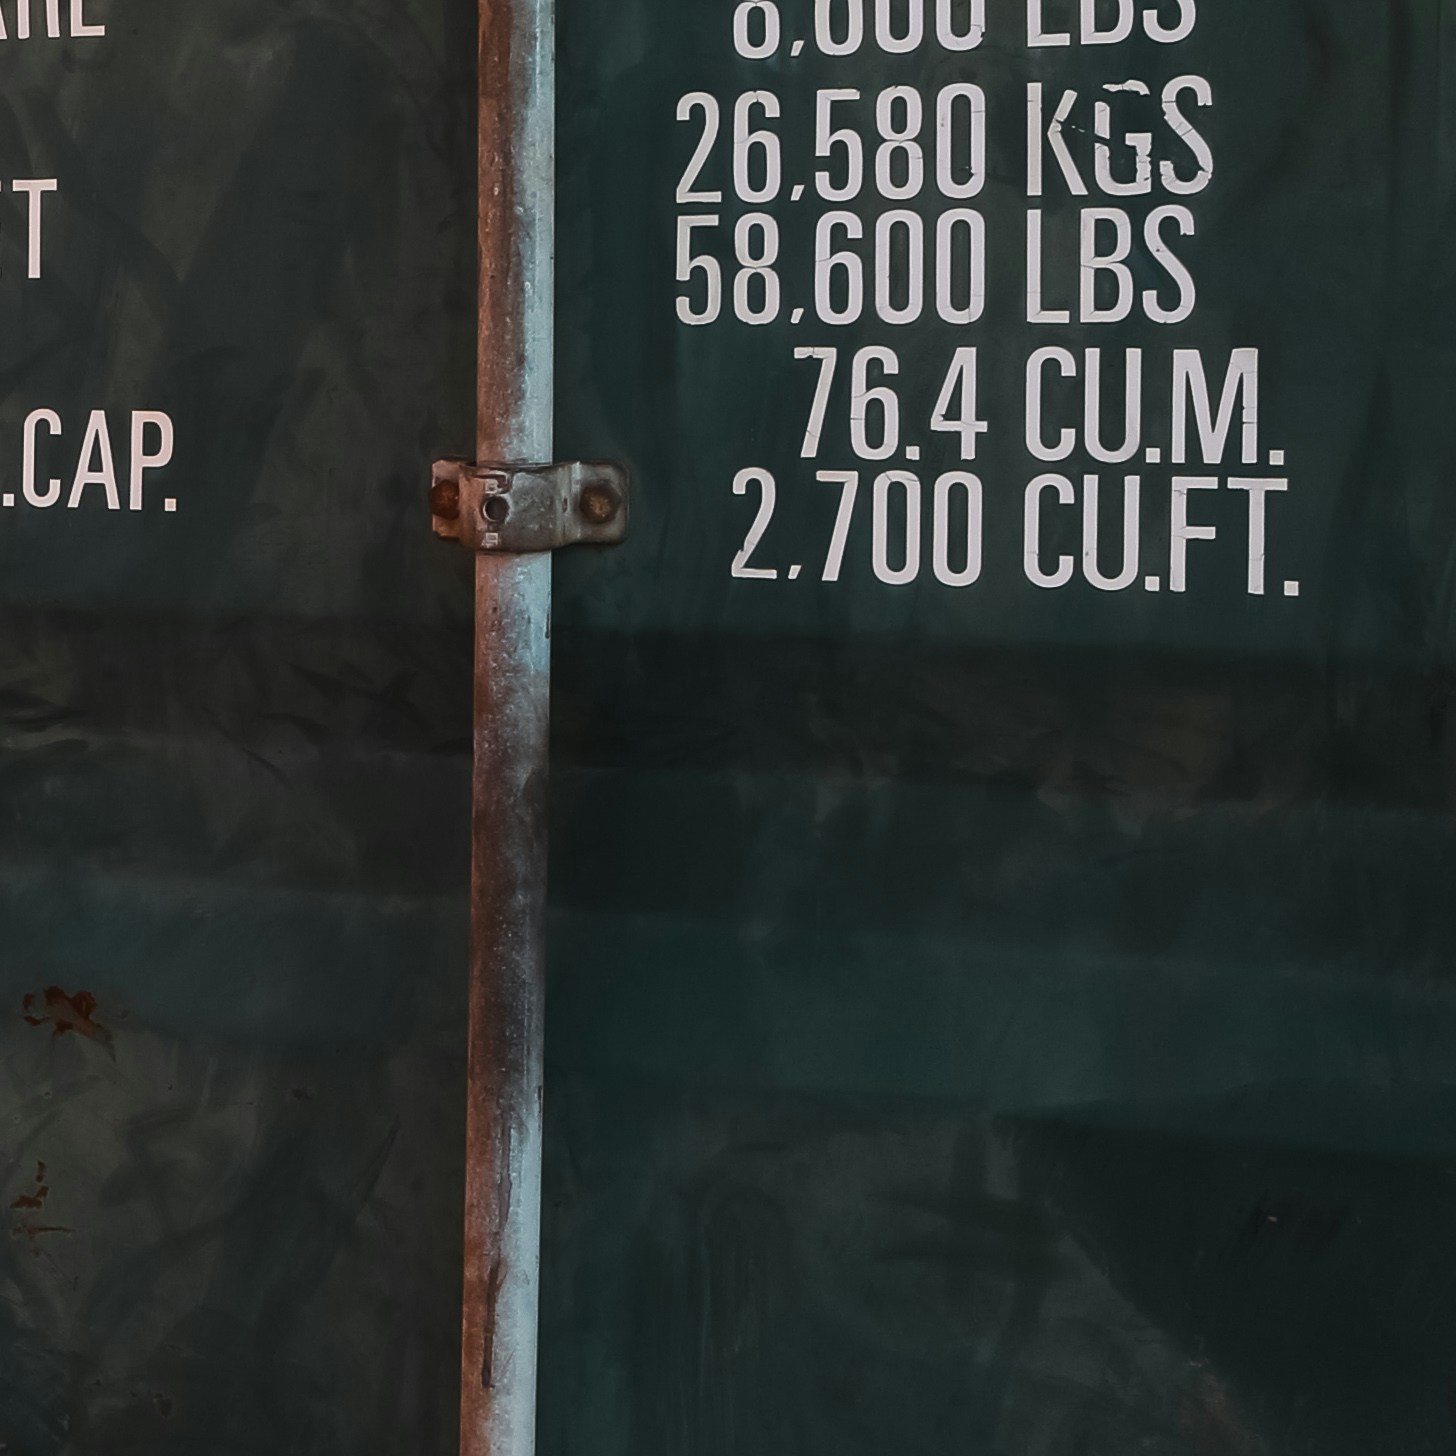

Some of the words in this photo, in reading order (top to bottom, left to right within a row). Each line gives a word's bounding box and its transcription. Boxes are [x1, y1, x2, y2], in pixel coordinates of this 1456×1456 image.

[676, 83, 985, 203] 26,580
[1027, 75, 1213, 196] KGS
[676, 208, 985, 325] 58,600
[1027, 205, 1195, 323] LBS
[794, 346, 987, 460] 76.4
[1026, 347, 1284, 465] CU.M.
[732, 467, 982, 586] 2,700
[1024, 474, 1299, 596] CU.FT.
